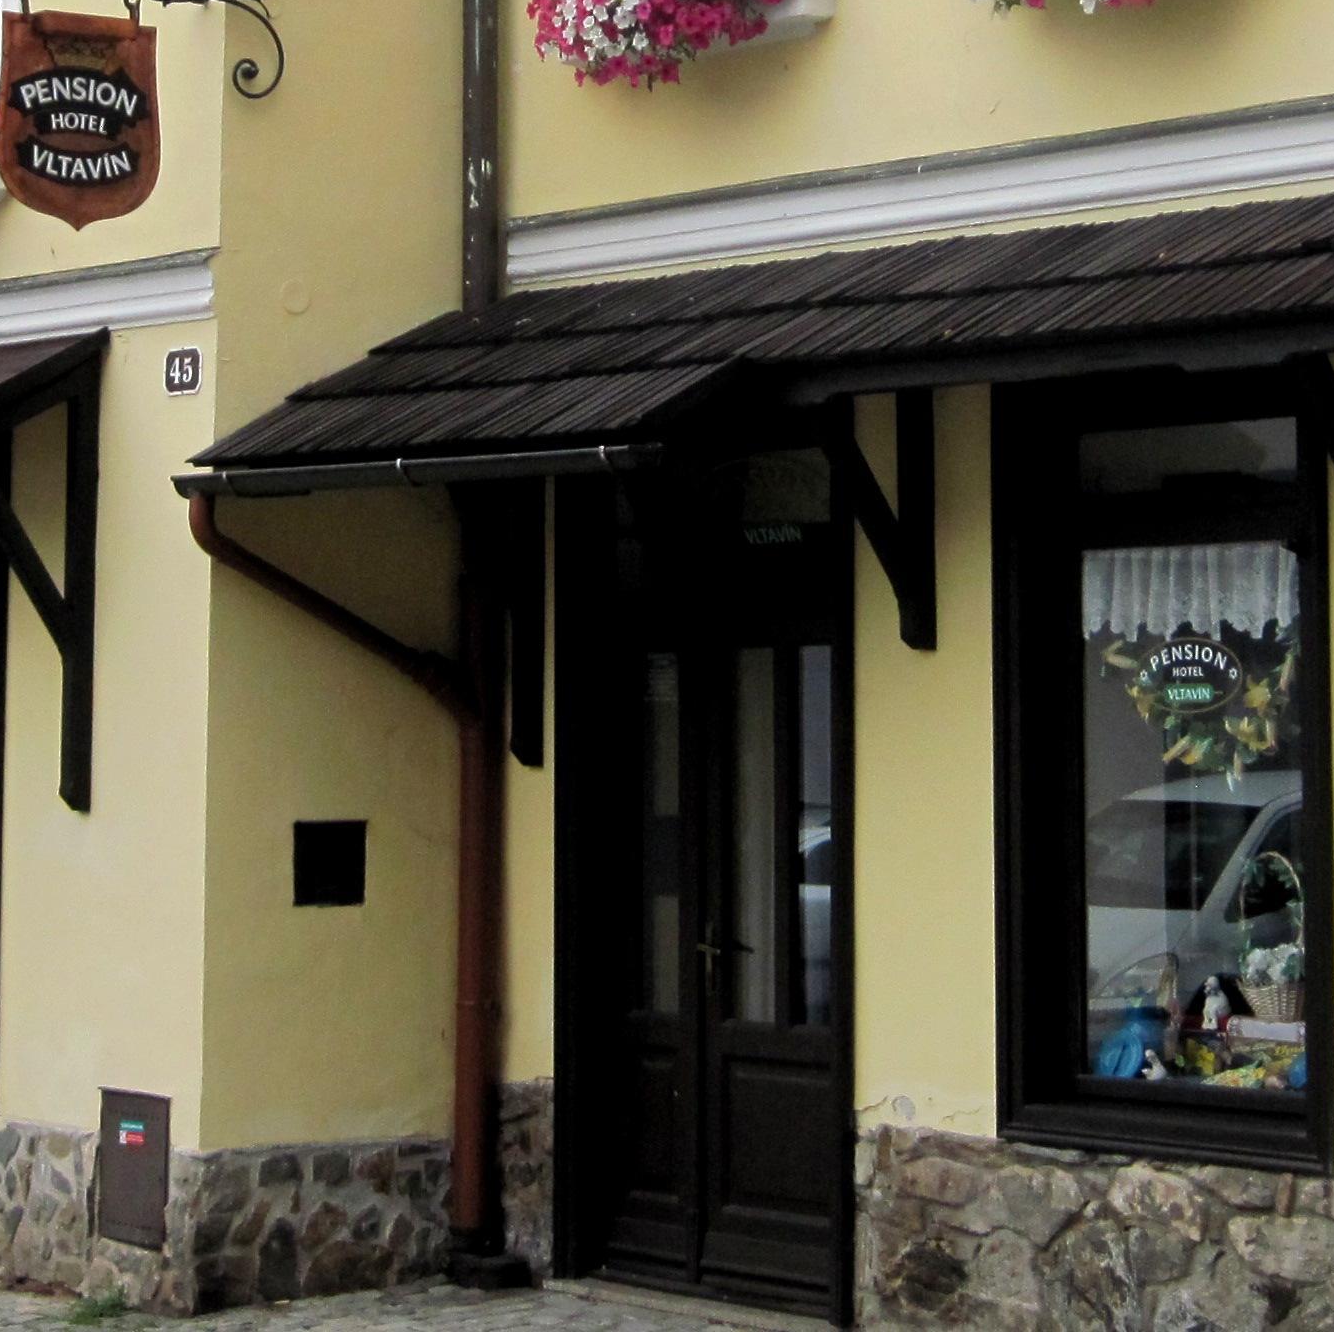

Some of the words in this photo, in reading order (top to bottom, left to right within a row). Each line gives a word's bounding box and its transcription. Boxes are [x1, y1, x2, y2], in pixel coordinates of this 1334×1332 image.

[19, 76, 138, 117] PENSION
[50, 112, 108, 135] HOTEL
[32, 145, 132, 180] VLTAVÍN
[169, 357, 193, 384] 45
[1150, 643, 1227, 671] PENSION
[1172, 666, 1204, 677] HOTEL
